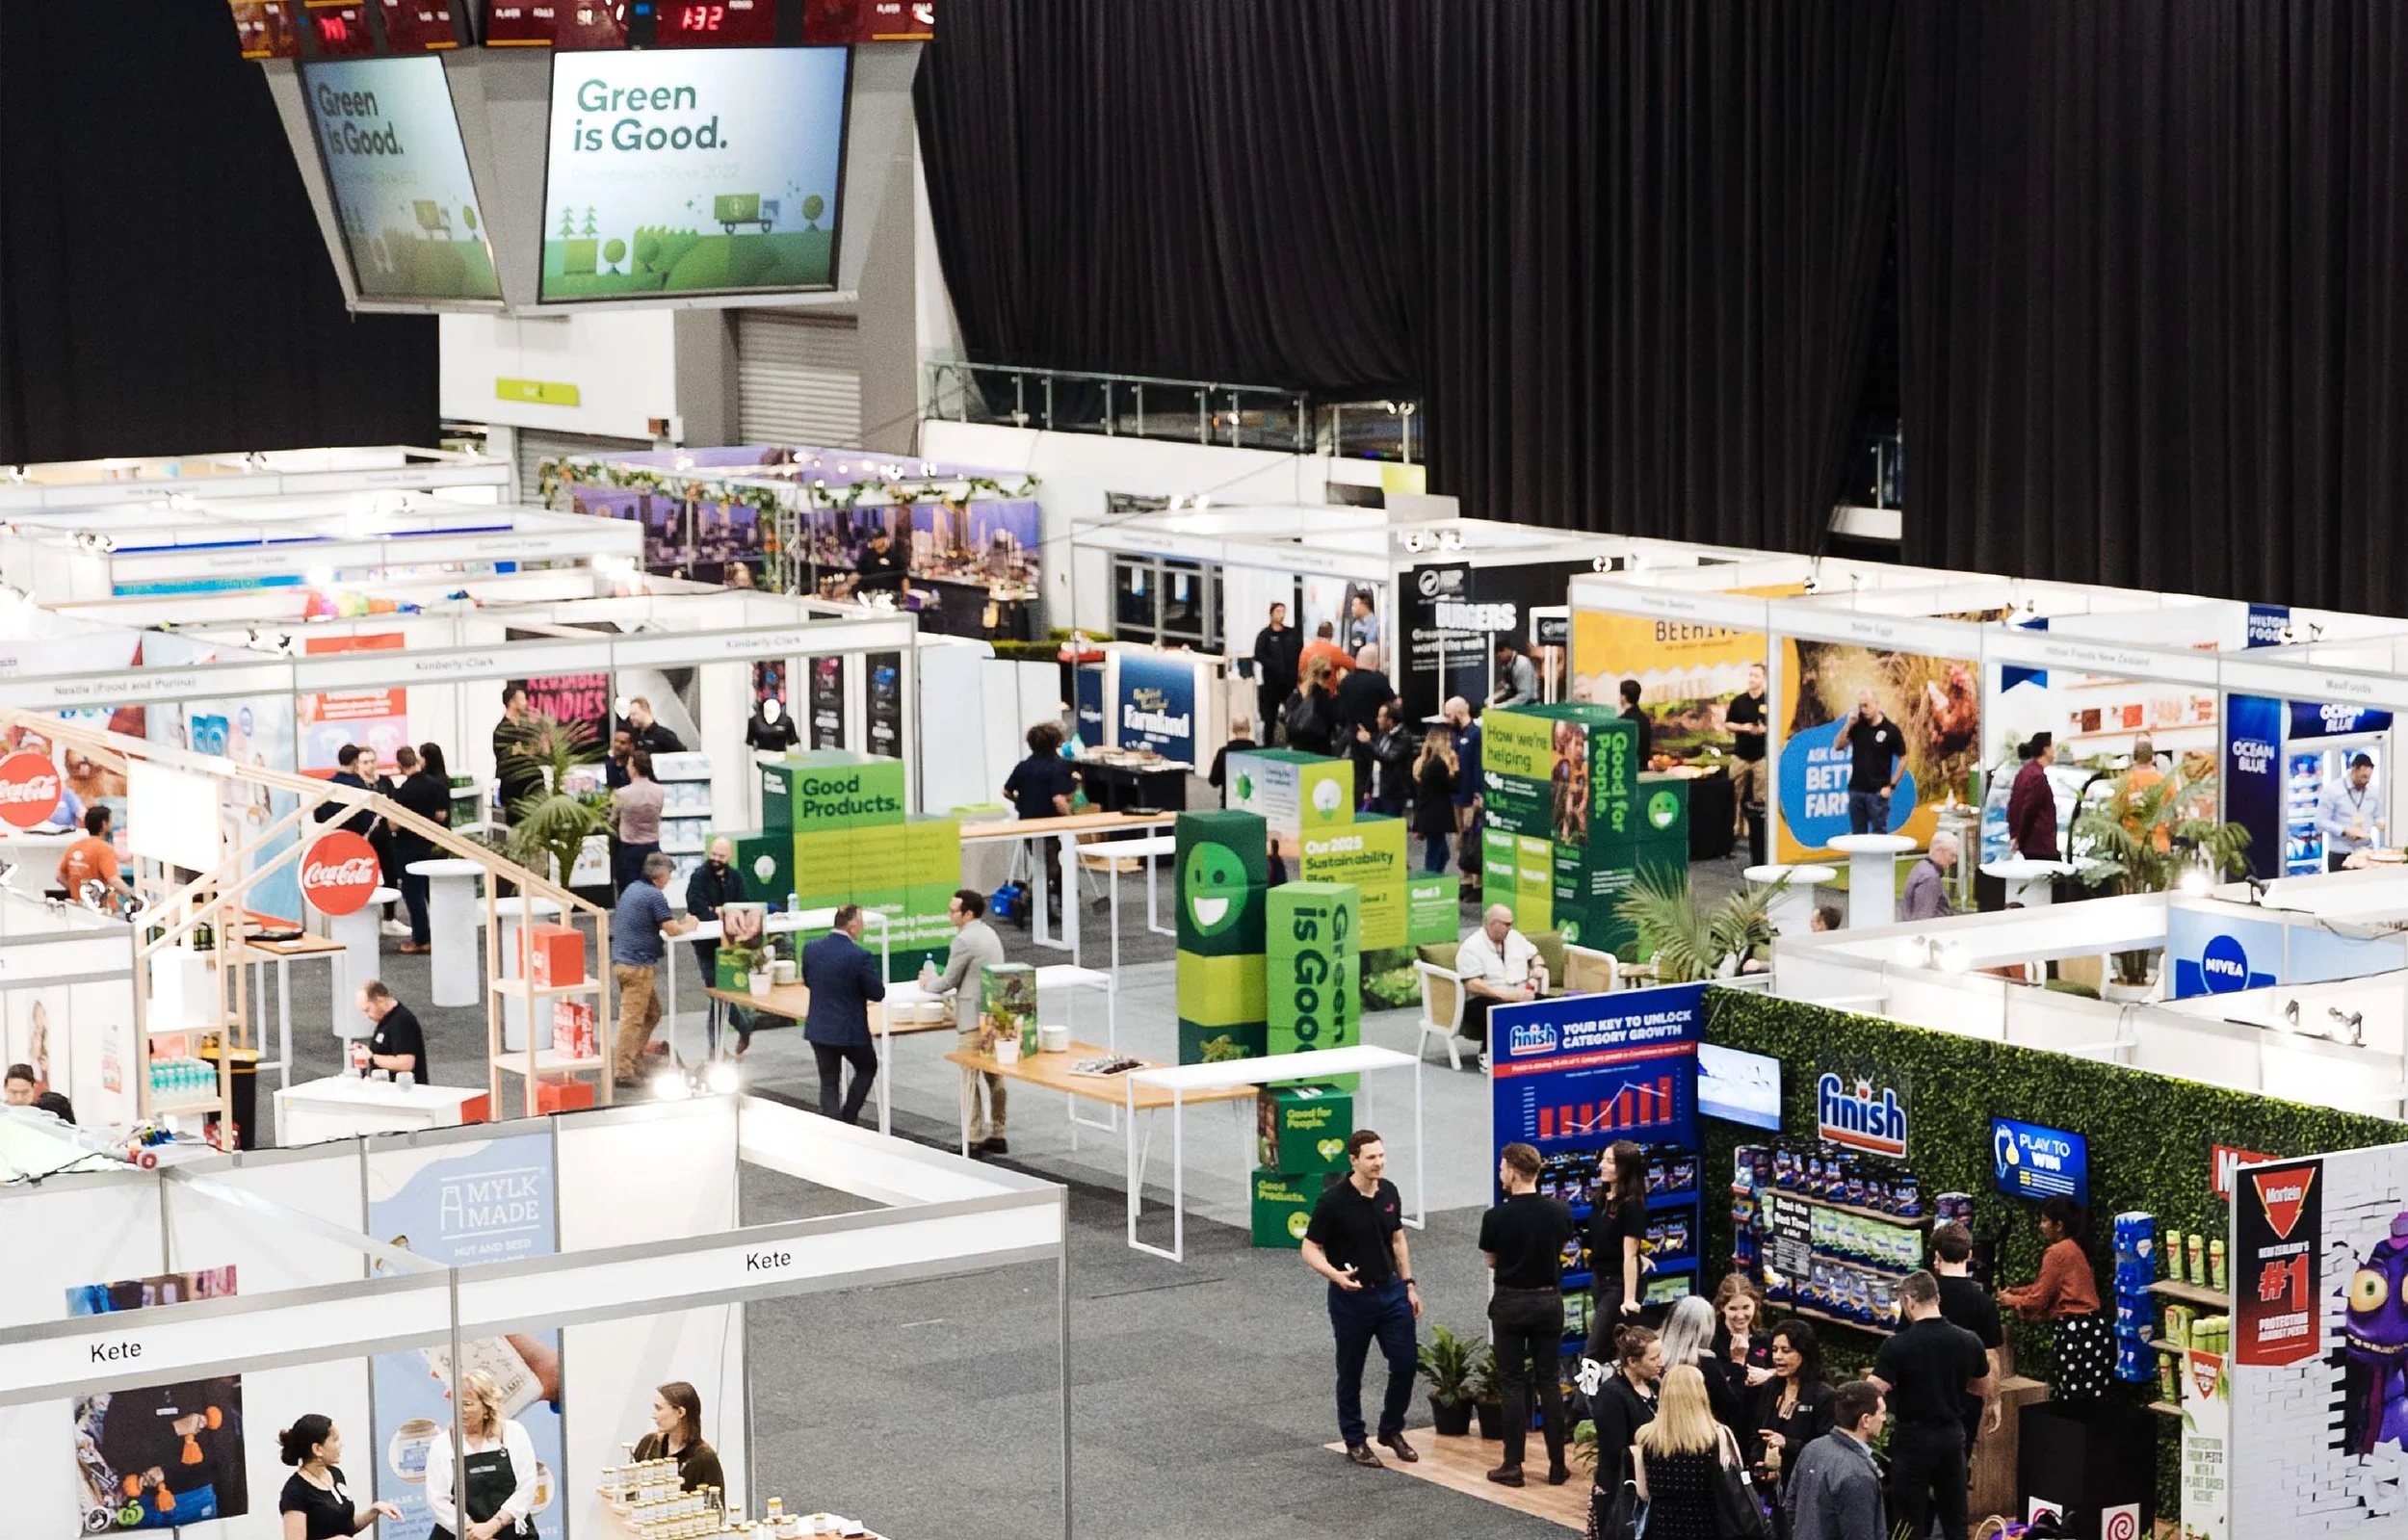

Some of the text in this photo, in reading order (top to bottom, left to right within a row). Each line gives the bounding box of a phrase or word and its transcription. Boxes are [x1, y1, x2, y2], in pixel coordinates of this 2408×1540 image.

[318, 83, 379, 117] Green
[577, 79, 696, 112] Green
[327, 121, 404, 155] is Good.
[574, 115, 727, 151] is Good.
[1656, 621, 1741, 641] BEEH
[2249, 627, 2280, 642] FOOD
[1486, 725, 1548, 749] How we're
[1486, 746, 1532, 771] helping
[2232, 741, 2275, 760] OCEAN
[1591, 732, 1611, 819] People.
[1806, 763, 1853, 792] BETT
[2238, 757, 2267, 774] BLUE
[0, 774, 58, 805] oca-Cola
[802, 774, 860, 796] Good
[1610, 731, 1630, 833] Good for
[802, 794, 902, 819] Products.
[1305, 838, 1330, 855] Our
[1306, 849, 1394, 872] Sustainability
[1332, 903, 1348, 1043] Green
[2205, 957, 2244, 978] NIVEA
[1293, 906, 1328, 1055] is Goo
[1562, 1009, 1692, 1036] YOUR KEY TO UNLOCK
[1512, 1024, 1557, 1049] finish
[1562, 1024, 1683, 1050] CATEGORY GROWTH
[1286, 1109, 1316, 1120] Good
[1819, 1076, 1905, 1141] finish
[2019, 1133, 2071, 1158] PLAY TO
[2030, 1151, 2061, 1172] WIN
[466, 1174, 539, 1204] MYLK
[2264, 1186, 2302, 1205] Mortein
[467, 1199, 540, 1229] MADE
[746, 1250, 792, 1272] Kete
[2257, 1252, 2310, 1312] #1
[91, 1341, 143, 1363] Kete
